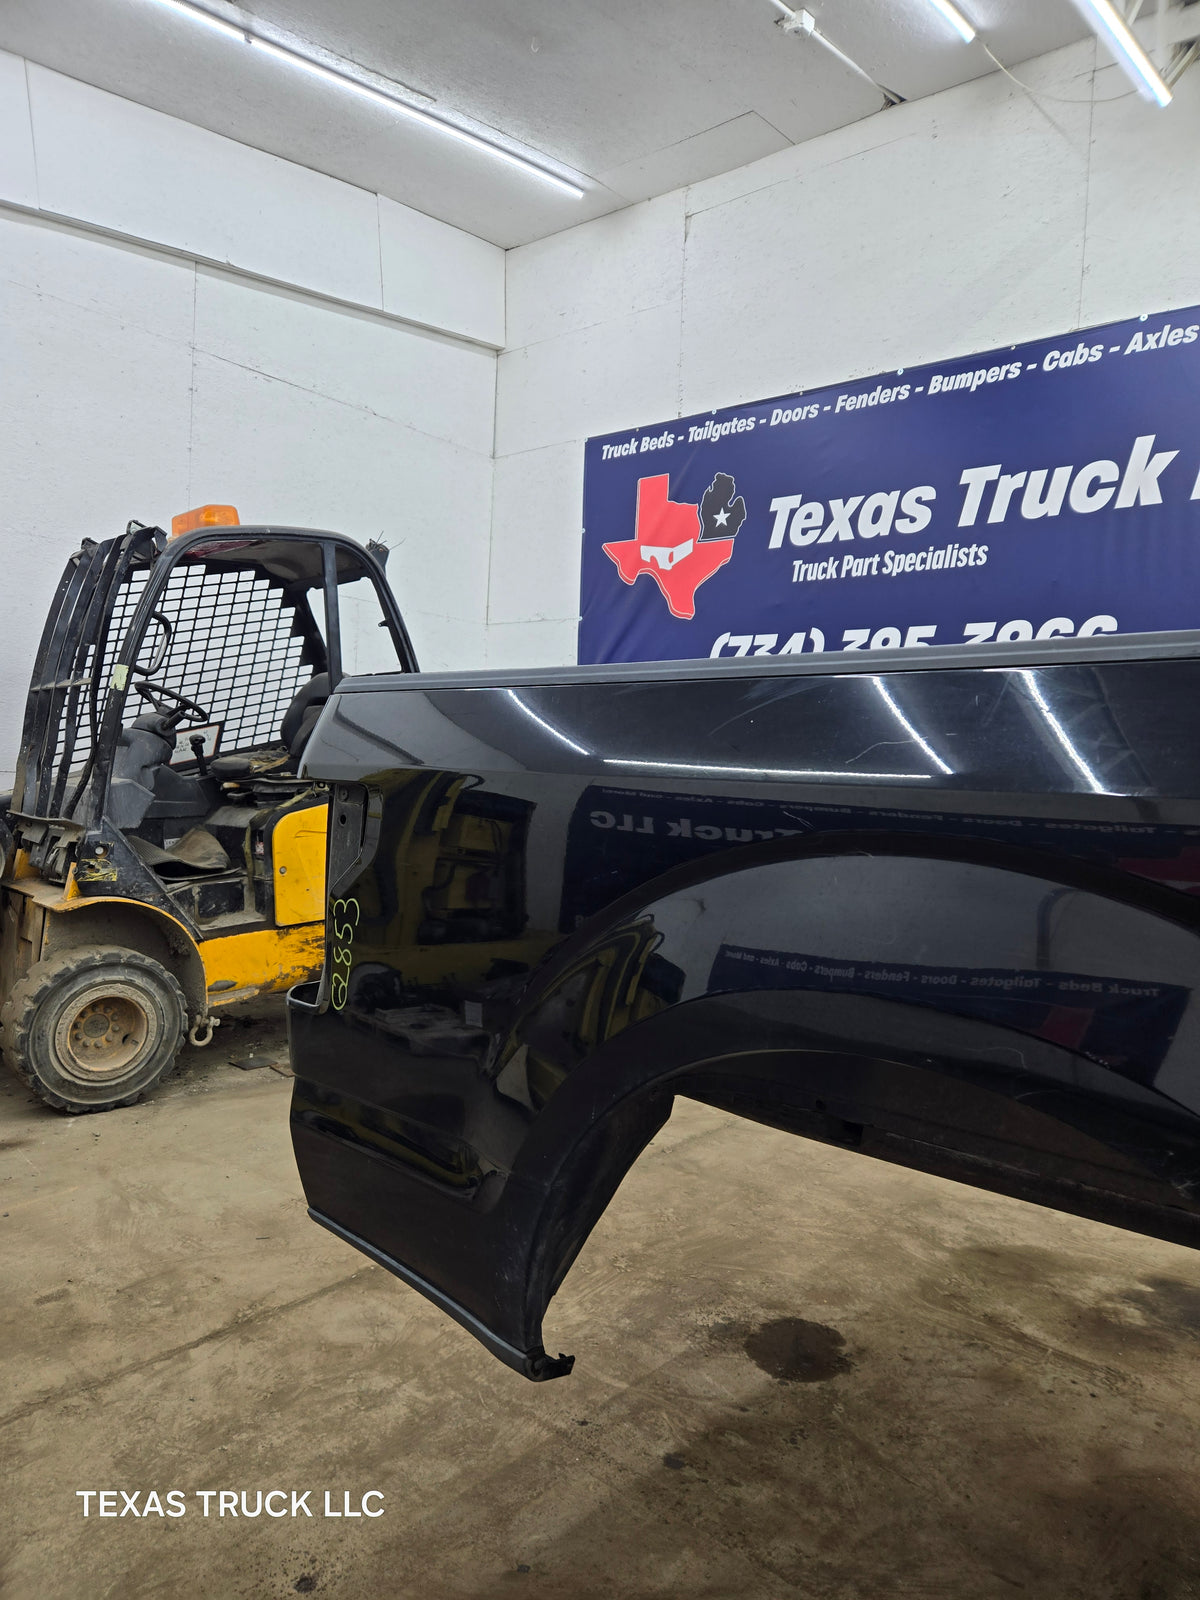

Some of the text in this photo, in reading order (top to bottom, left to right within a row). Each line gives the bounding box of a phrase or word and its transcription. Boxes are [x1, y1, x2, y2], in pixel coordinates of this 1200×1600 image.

[601, 437, 639, 460] Truck
[640, 430, 675, 453] Beds
[688, 416, 757, 443] Tailgates
[770, 403, 820, 427] Doors
[835, 384, 911, 414] Fenders
[928, 361, 1023, 395] Bumpers
[1042, 342, 1105, 372] Cabs
[1123, 324, 1200, 356] Axles
[768, 485, 937, 550] Texas
[957, 434, 1180, 528] Truck
[792, 542, 990, 583] Truck Part Specialists
